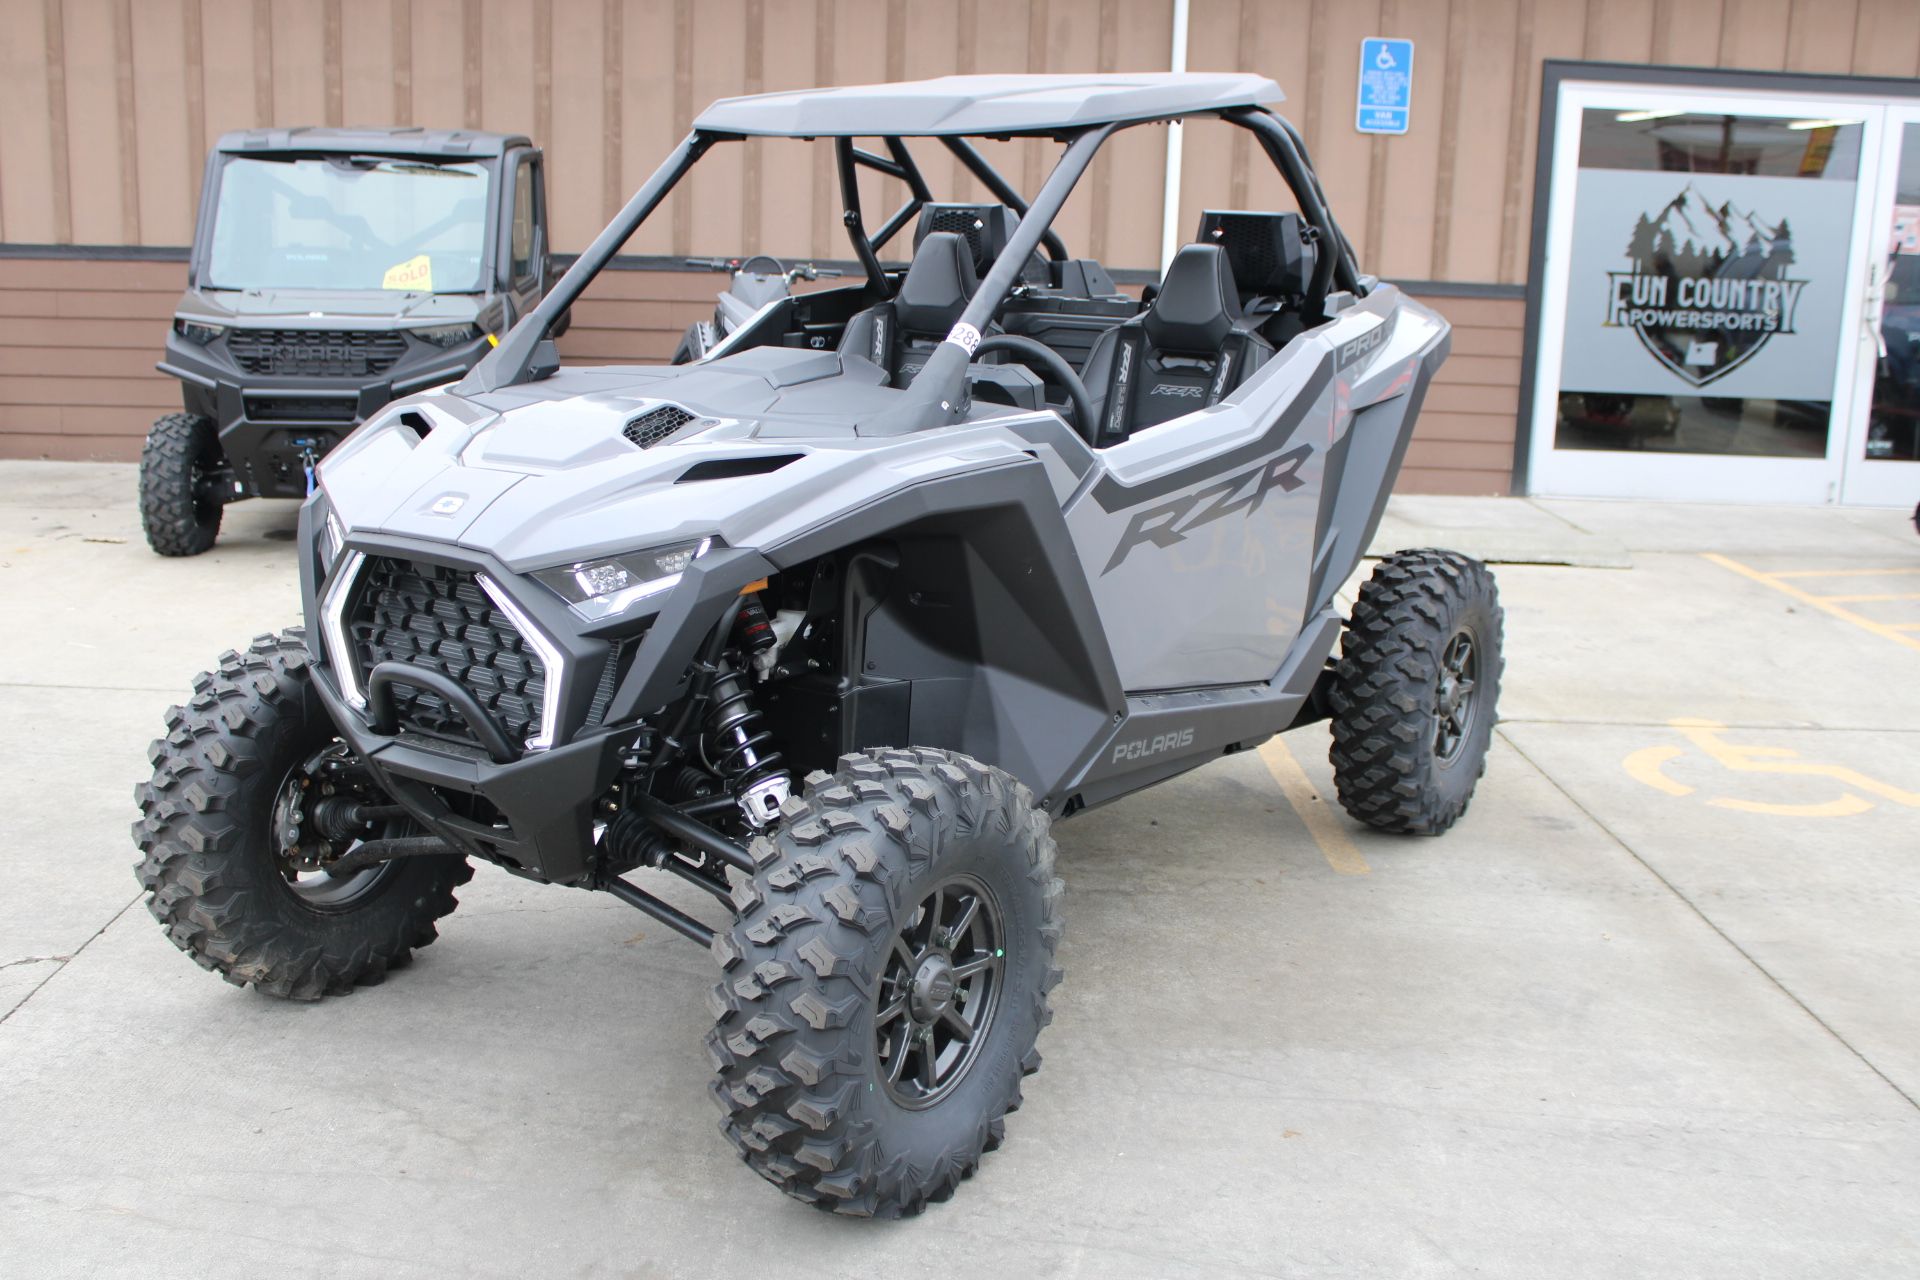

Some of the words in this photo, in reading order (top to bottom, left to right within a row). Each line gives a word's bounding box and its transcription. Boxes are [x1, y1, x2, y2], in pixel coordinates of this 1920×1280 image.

[1607, 272, 1669, 327] FUN
[1677, 275, 1808, 333] COUNTRY
[1629, 308, 1779, 332] POWERSPORTS
[258, 344, 367, 361] POLARIS
[1118, 342, 1132, 383] RZR
[1341, 325, 1383, 365] PRO
[1150, 384, 1204, 397] RZR
[1213, 353, 1231, 394] RZR
[1099, 443, 1315, 578] RZR
[1112, 727, 1195, 764] POLARIS
